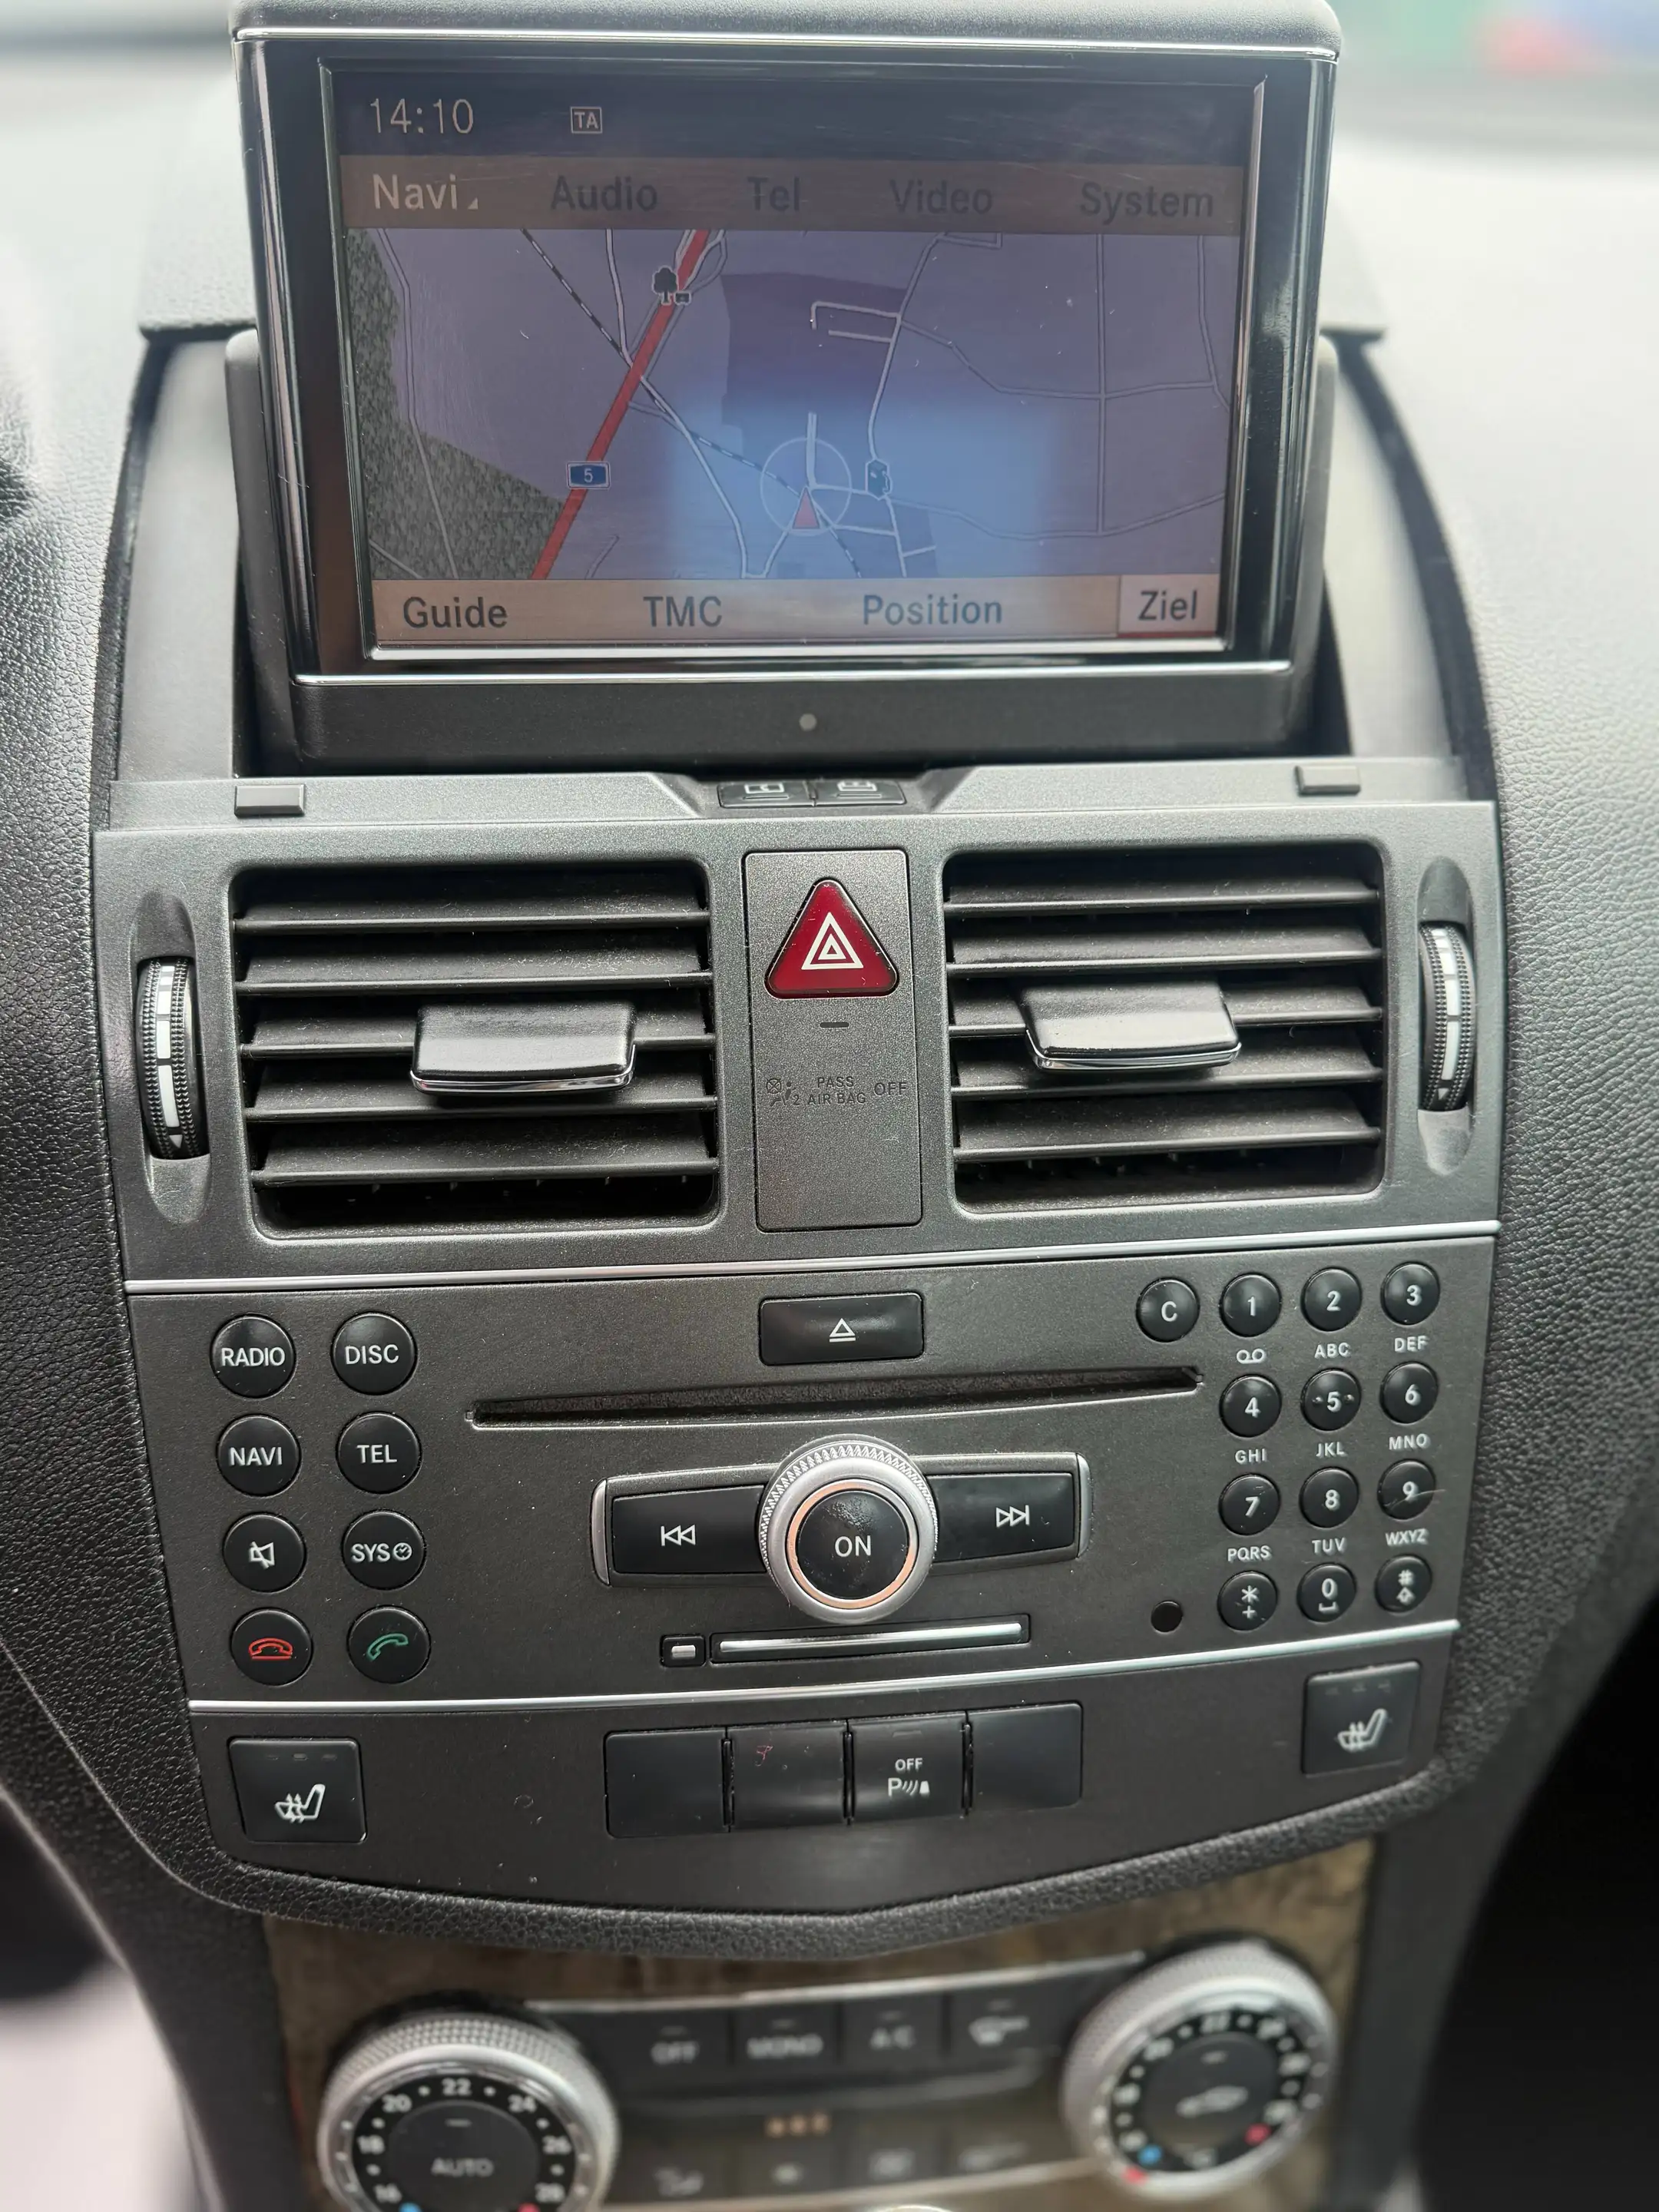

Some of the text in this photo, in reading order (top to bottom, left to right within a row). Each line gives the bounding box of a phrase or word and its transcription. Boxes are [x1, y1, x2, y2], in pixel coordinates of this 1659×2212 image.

[370, 98, 474, 134] 14:10
[574, 112, 599, 129] TA
[373, 174, 1214, 225] Navi Audio Tel Video System
[584, 468, 594, 484] 5
[402, 589, 1197, 629] Guide TMC Position Ziel
[817, 1076, 855, 1089] PASS
[873, 1081, 907, 1096] OFF
[806, 1091, 866, 1106] AIR BAG
[1326, 1290, 1340, 1312] 2
[1406, 1284, 1422, 1306] 3
[1161, 1301, 1177, 1323] C
[1247, 1296, 1256, 1316] 1
[345, 1343, 399, 1365] DISC
[1314, 1343, 1351, 1359] ABC
[1394, 1336, 1429, 1353] DEF
[220, 1346, 286, 1368] RADIO
[1327, 1391, 1340, 1412] 5
[1405, 1384, 1420, 1406] 6
[1244, 1397, 1260, 1417] 4
[1316, 1441, 1346, 1457] JKL
[1389, 1434, 1429, 1450] MNO
[230, 1445, 283, 1467] NAVI
[356, 1444, 397, 1465] TEL
[1234, 1449, 1267, 1463] GHI
[1325, 1489, 1340, 1510] 8
[1402, 1482, 1417, 1501] 9
[1244, 1496, 1260, 1518] 7
[835, 1535, 872, 1558] ON
[1312, 1538, 1346, 1554] TUV
[1386, 1529, 1429, 1546] WXYZ
[350, 1542, 391, 1563] SYS
[1227, 1545, 1272, 1561] PQRS
[1322, 1578, 1336, 1598] 0
[895, 1757, 923, 1773] OFF
[651, 2042, 698, 2065] OFF
[442, 2078, 472, 2096] 22
[382, 2095, 412, 2112] 20
[508, 2094, 536, 2112] 24
[432, 2158, 494, 2177] AUTO
